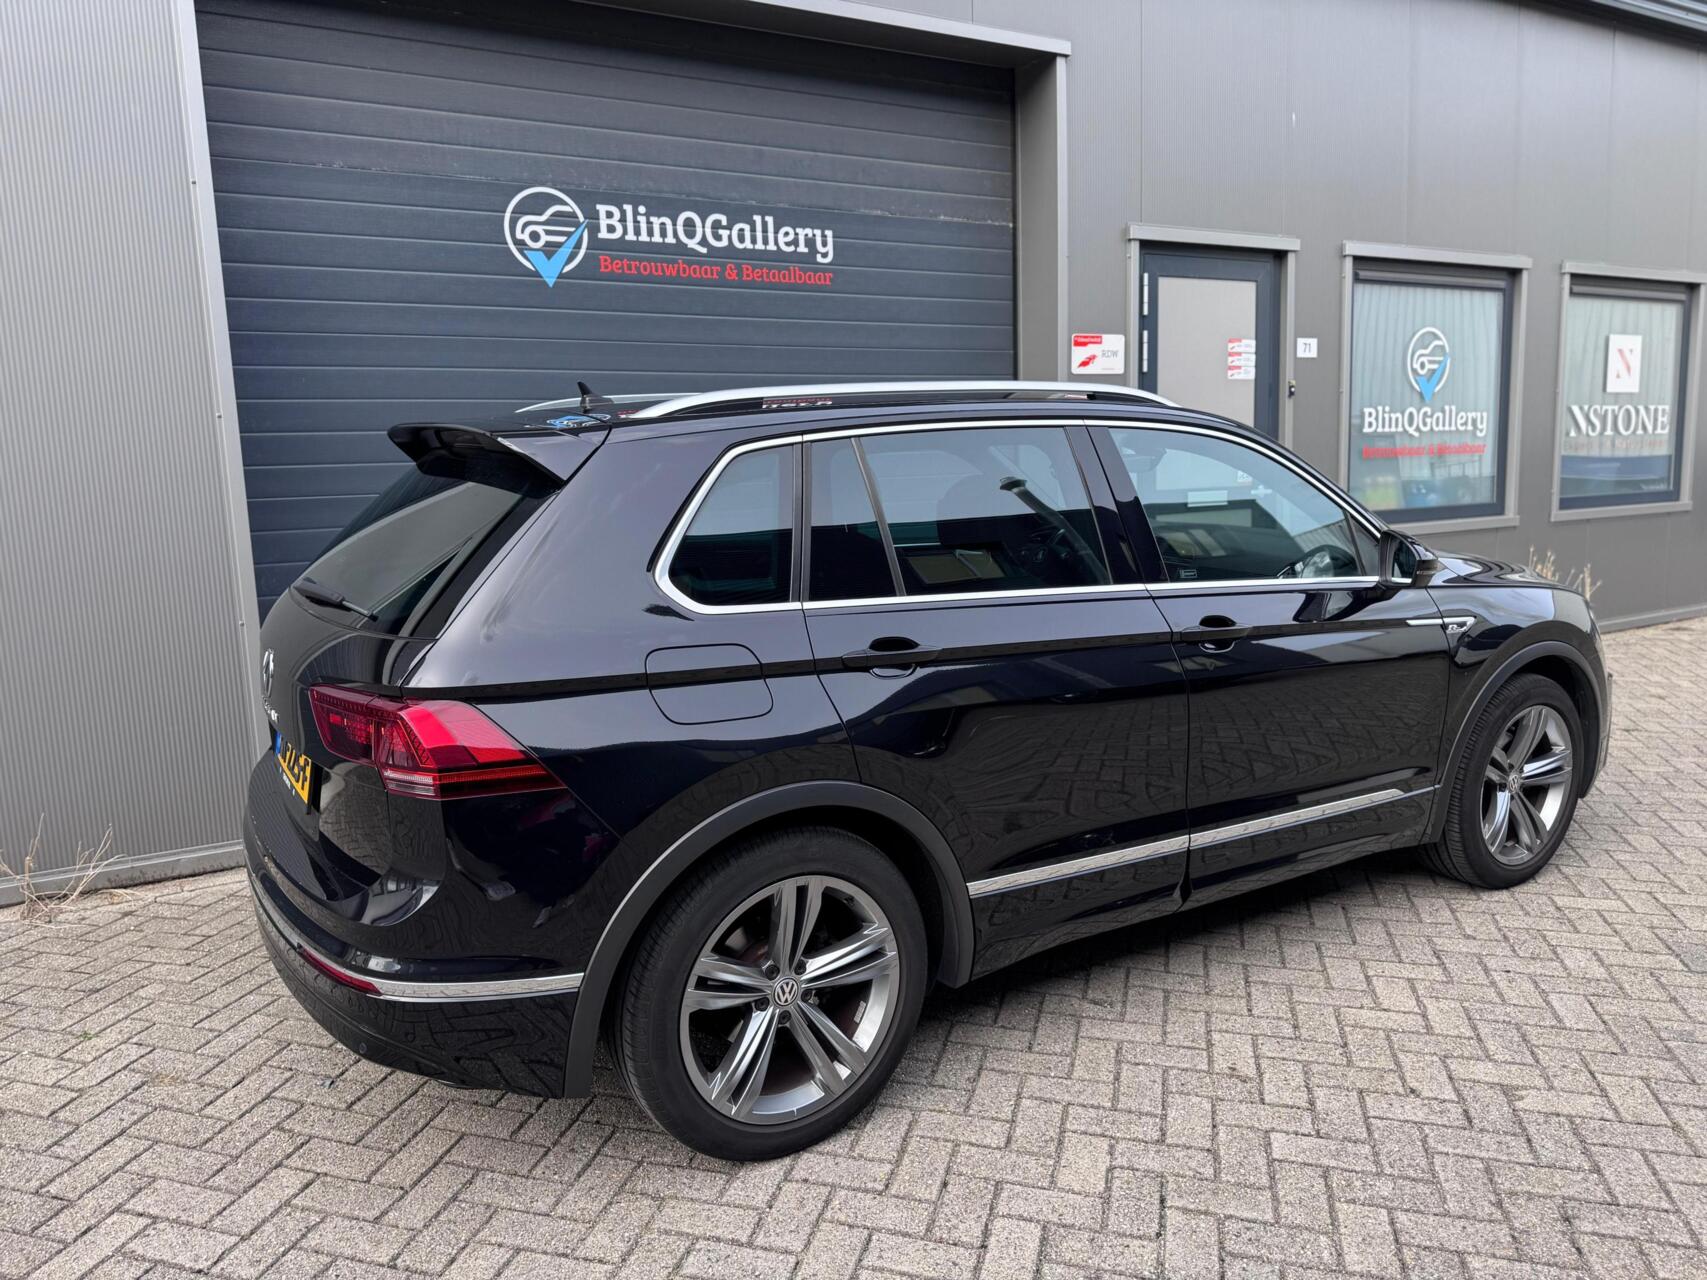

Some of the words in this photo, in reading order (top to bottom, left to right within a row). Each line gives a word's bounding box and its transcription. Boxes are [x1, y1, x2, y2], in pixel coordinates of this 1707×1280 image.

[596, 203, 835, 264] BlinQGallery
[598, 255, 721, 281] Betrouwbaar
[725, 264, 738, 281] &
[742, 264, 834, 286] Betaalbaar
[1302, 342, 1312, 353] 71
[1362, 405, 1488, 437] BlinQGallery
[1569, 404, 1670, 437] NSTONE
